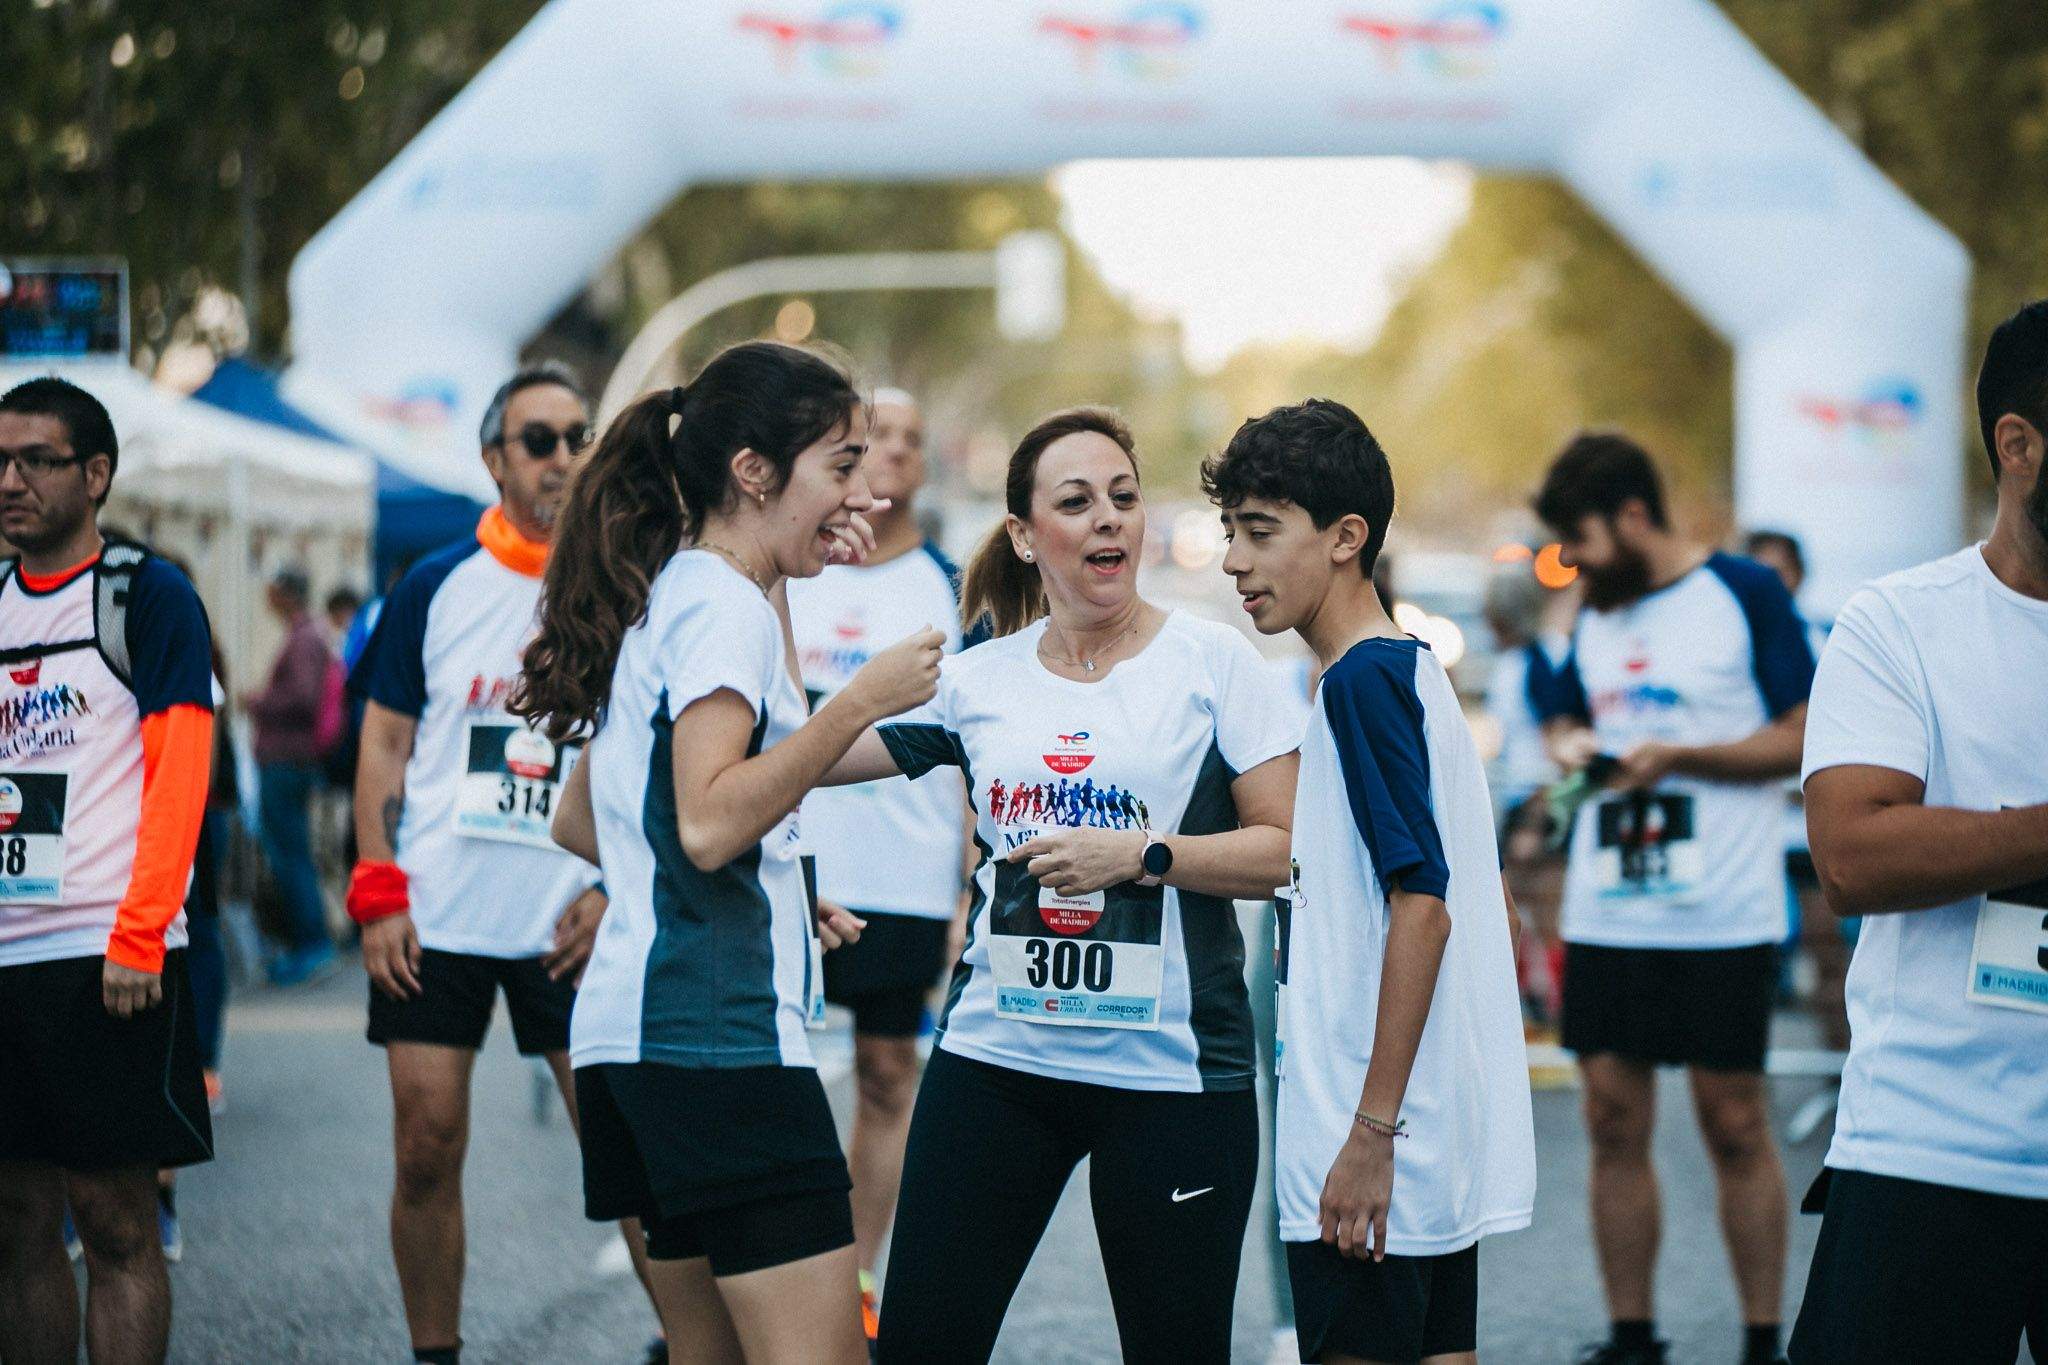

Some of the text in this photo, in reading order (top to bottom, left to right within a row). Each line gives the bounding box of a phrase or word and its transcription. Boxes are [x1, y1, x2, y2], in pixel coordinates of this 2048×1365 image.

[498, 782, 551, 818] 314
[0, 837, 27, 877] 8
[1050, 917, 1090, 926] DE MADRID
[1059, 910, 1082, 919] MILLA
[1025, 938, 1113, 993] 300
